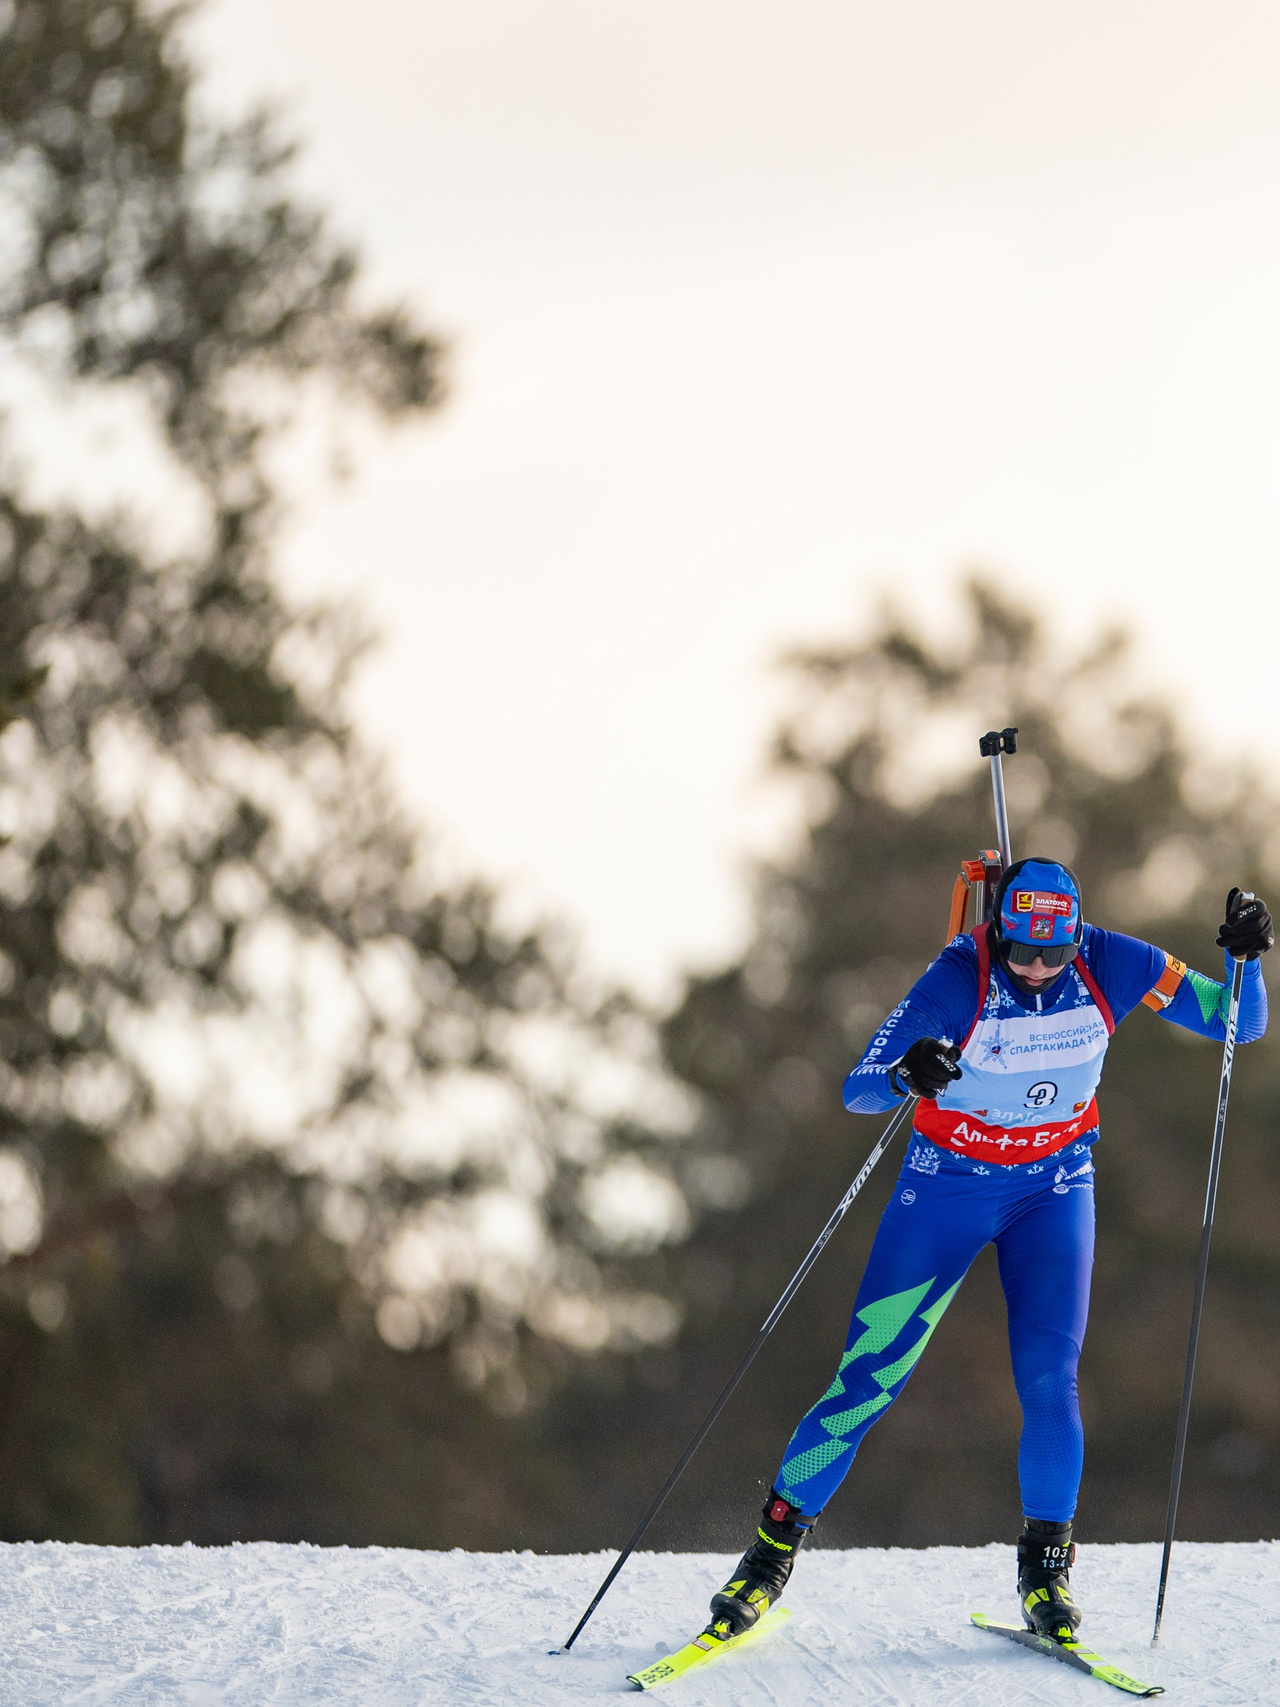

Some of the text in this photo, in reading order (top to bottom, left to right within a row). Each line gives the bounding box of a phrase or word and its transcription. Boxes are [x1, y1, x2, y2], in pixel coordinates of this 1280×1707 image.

[1035, 898, 1068, 908] ЗЛАТОУСТ
[1009, 1029, 1105, 1056] СПАРТАКИАДА 224
[1023, 1080, 1058, 1109] 3
[1043, 1545, 1068, 1558] 103
